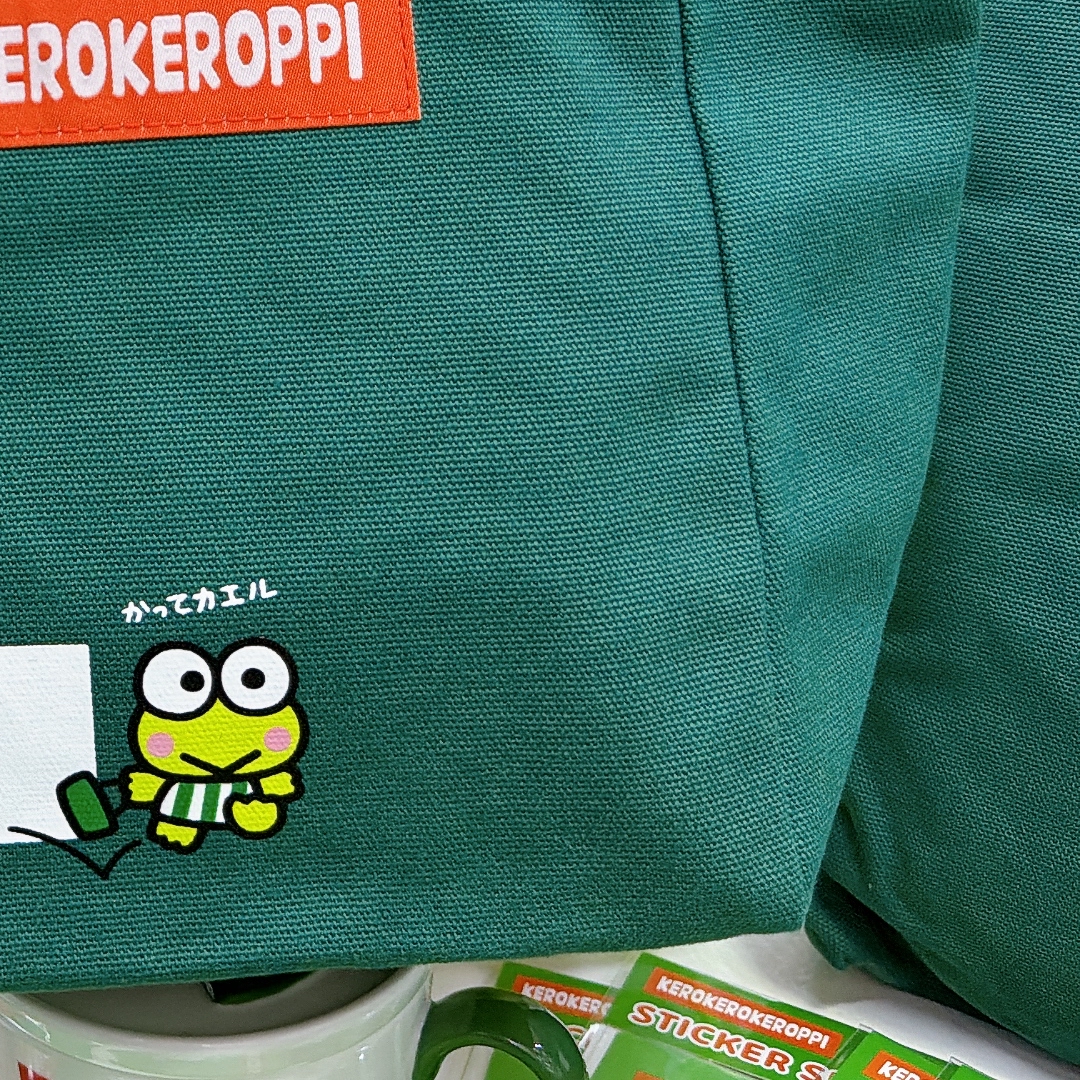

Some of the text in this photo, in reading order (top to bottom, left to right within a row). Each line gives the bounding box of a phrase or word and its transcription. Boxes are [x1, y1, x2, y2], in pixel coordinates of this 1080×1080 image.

[121, 578, 278, 623] かってカエル
[627, 1002, 794, 1075] STICKER
[656, 975, 830, 1049] KEROKEROKEROPPI
